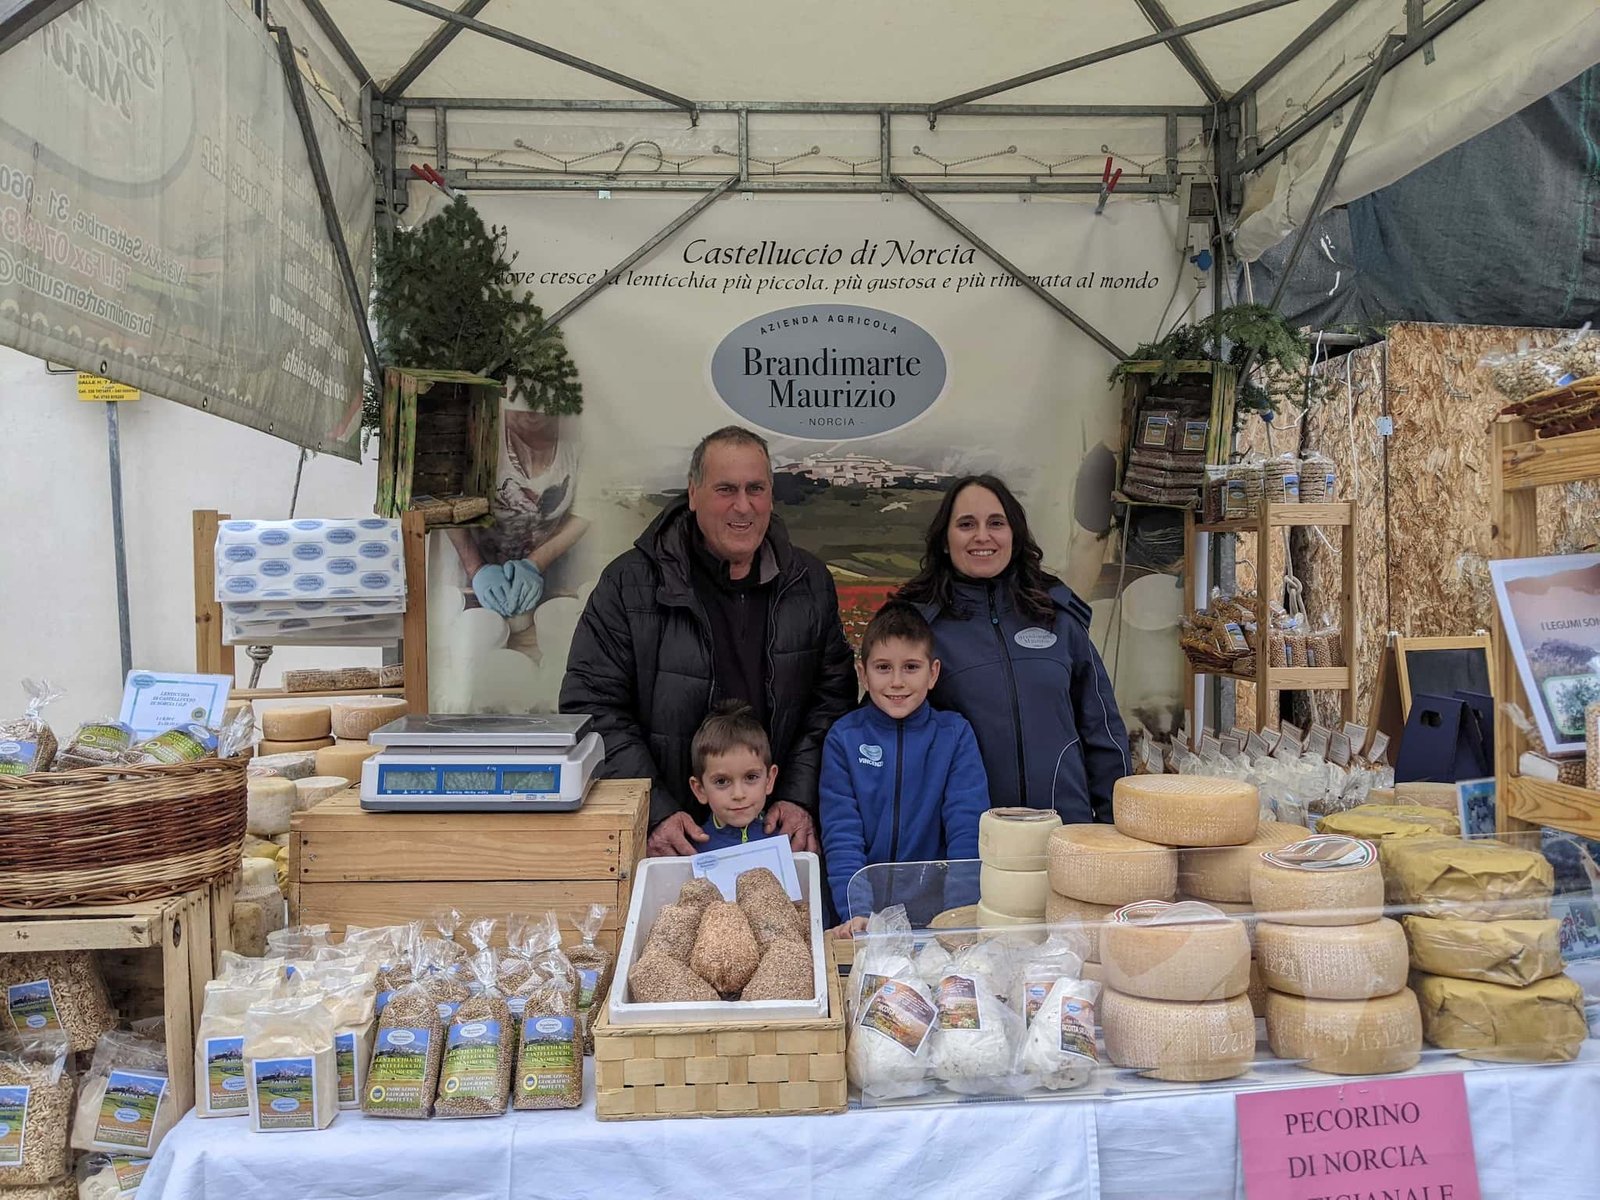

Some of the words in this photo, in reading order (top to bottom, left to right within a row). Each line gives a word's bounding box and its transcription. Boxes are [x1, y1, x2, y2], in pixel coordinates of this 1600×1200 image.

[683, 238, 843, 266] Castelluccio
[851, 239, 878, 266] di
[880, 239, 976, 268] Norcia
[540, 270, 596, 285] cresce
[626, 270, 717, 290] lenticchia
[722, 273, 752, 294] più
[833, 273, 863, 294] più
[867, 275, 936, 293] gustosa
[942, 277, 952, 289] e
[956, 272, 986, 294] più
[1076, 271, 1095, 289] al
[1099, 271, 1159, 290] mondo
[760, 314, 819, 335] AZIENDA
[827, 314, 899, 336] AGRICOLA
[742, 346, 921, 377] Brandimarte
[768, 378, 896, 409] Maurizio
[808, 417, 855, 426] NORCIA
[1546, 619, 1582, 631] LEGUMI
[1284, 1102, 1420, 1136] PECORINO
[1288, 1154, 1316, 1179] DI
[1323, 1144, 1428, 1176] NORCIA
